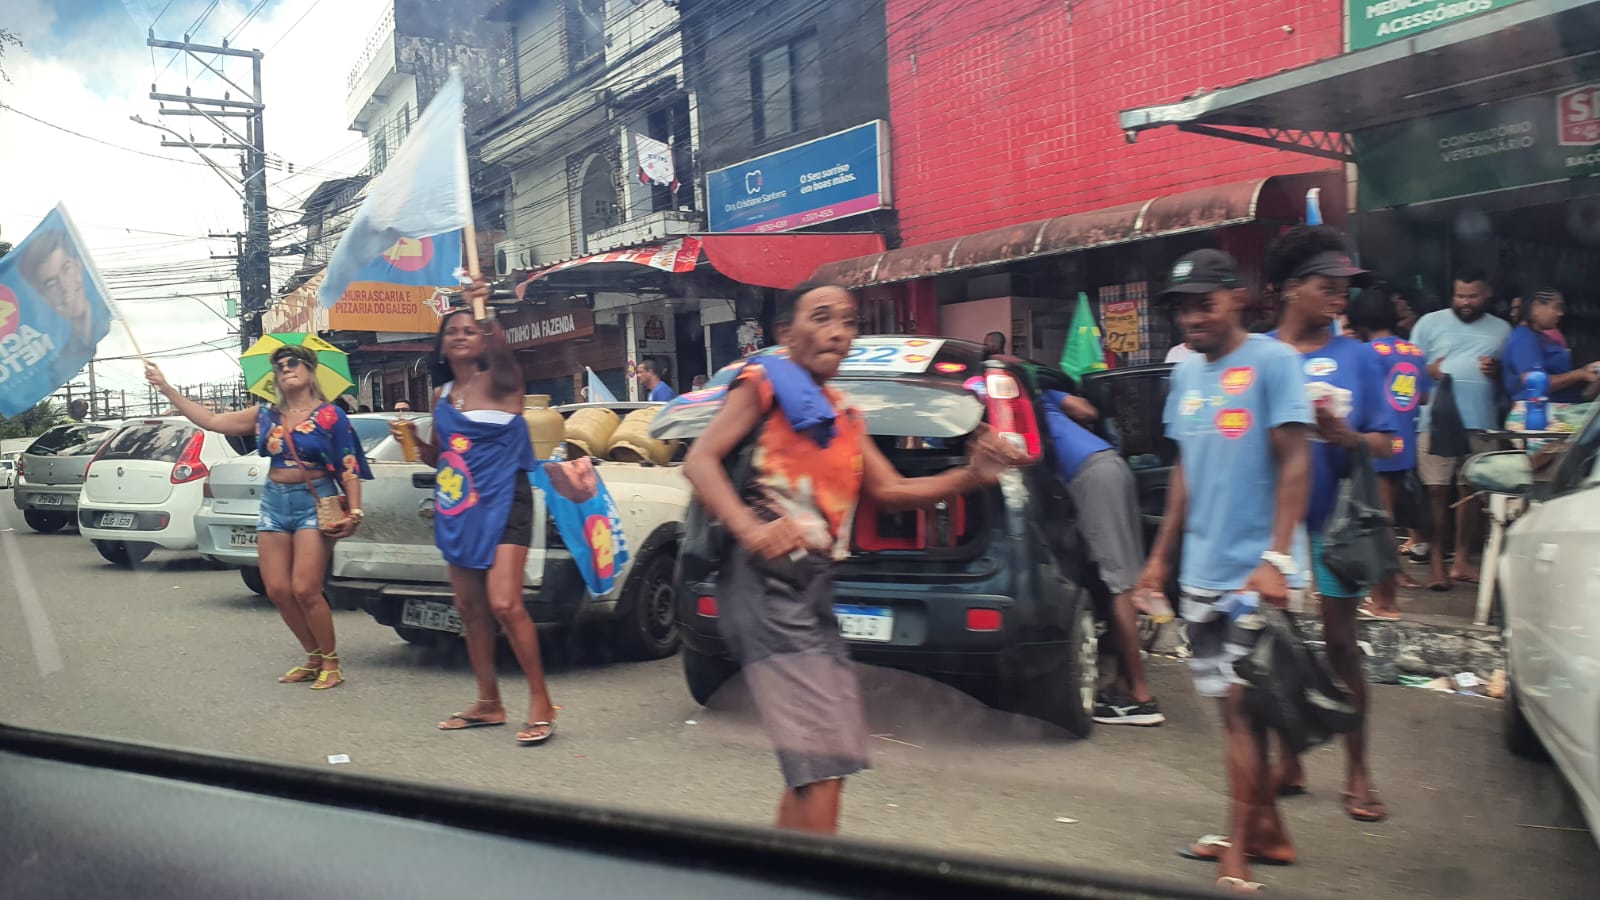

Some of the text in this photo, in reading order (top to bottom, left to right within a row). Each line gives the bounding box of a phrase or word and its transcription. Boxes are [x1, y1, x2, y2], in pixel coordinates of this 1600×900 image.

[1376, 0, 1492, 36] ACESSÓRIOS
[335, 302, 418, 315] PIZZARIA DO GALEGO
[503, 313, 576, 345] NTINHO DA FAZENDA
